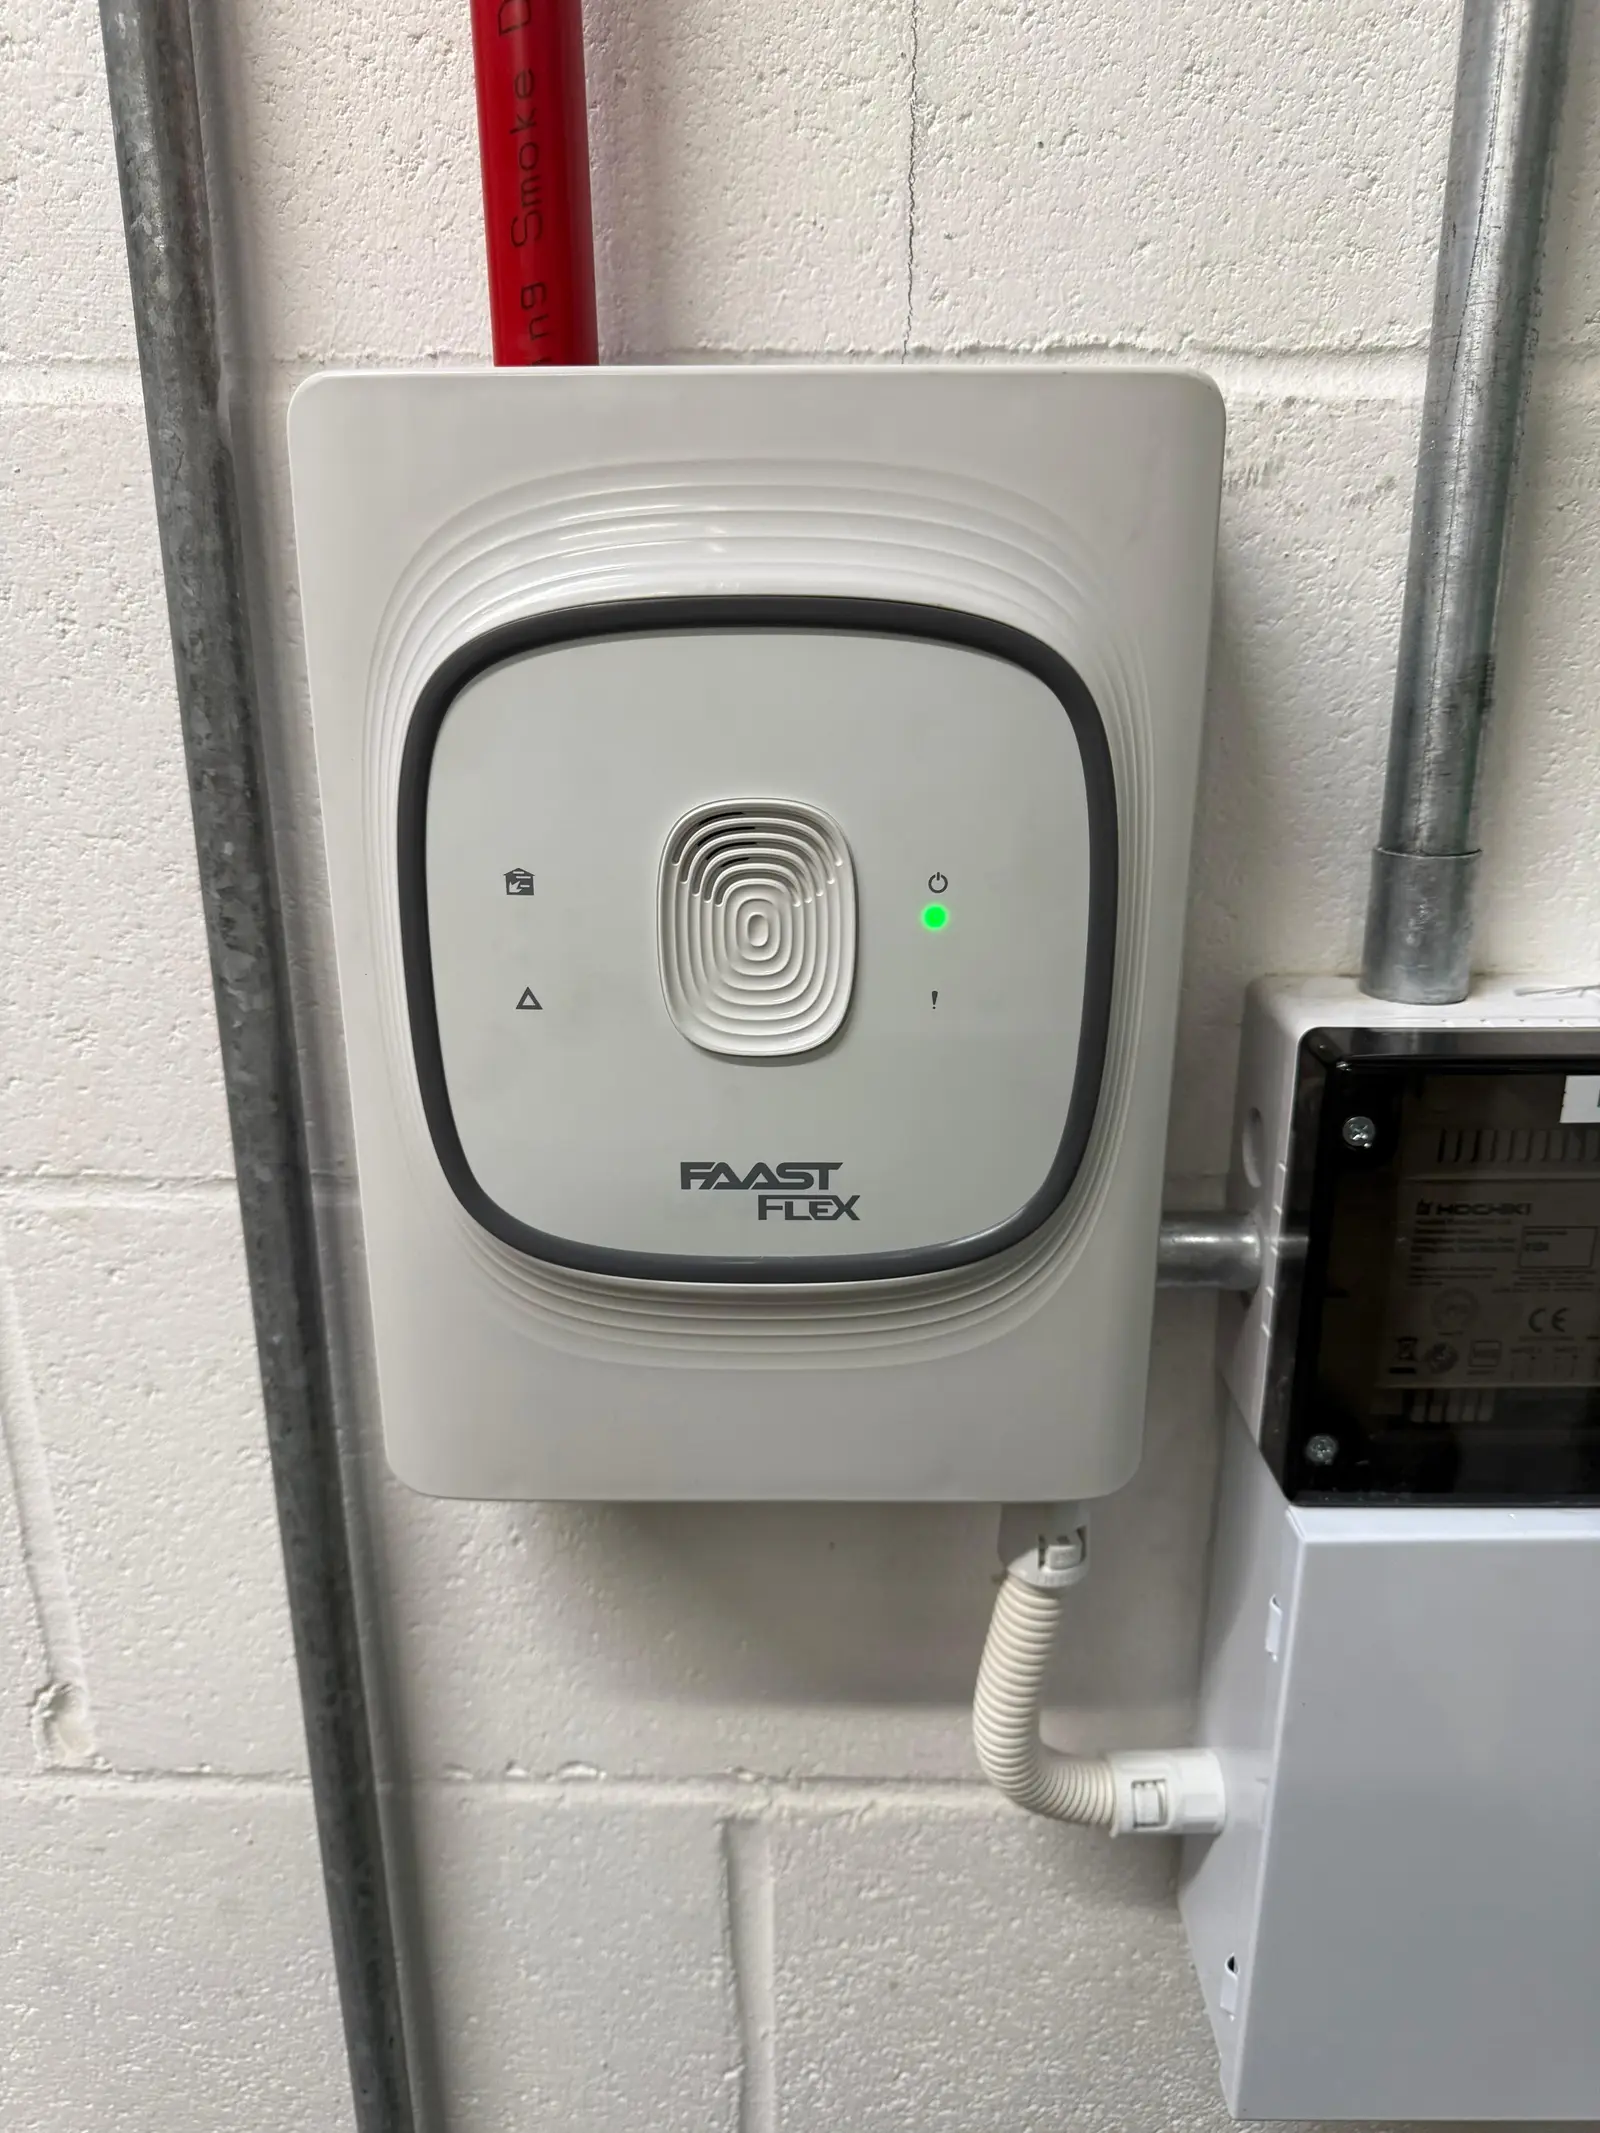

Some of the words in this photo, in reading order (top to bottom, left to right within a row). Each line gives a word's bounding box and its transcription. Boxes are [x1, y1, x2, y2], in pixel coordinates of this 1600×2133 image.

[509, 68, 543, 248] Smoke
[680, 1161, 844, 1190] FAAST
[758, 1194, 861, 1221] FLEX
